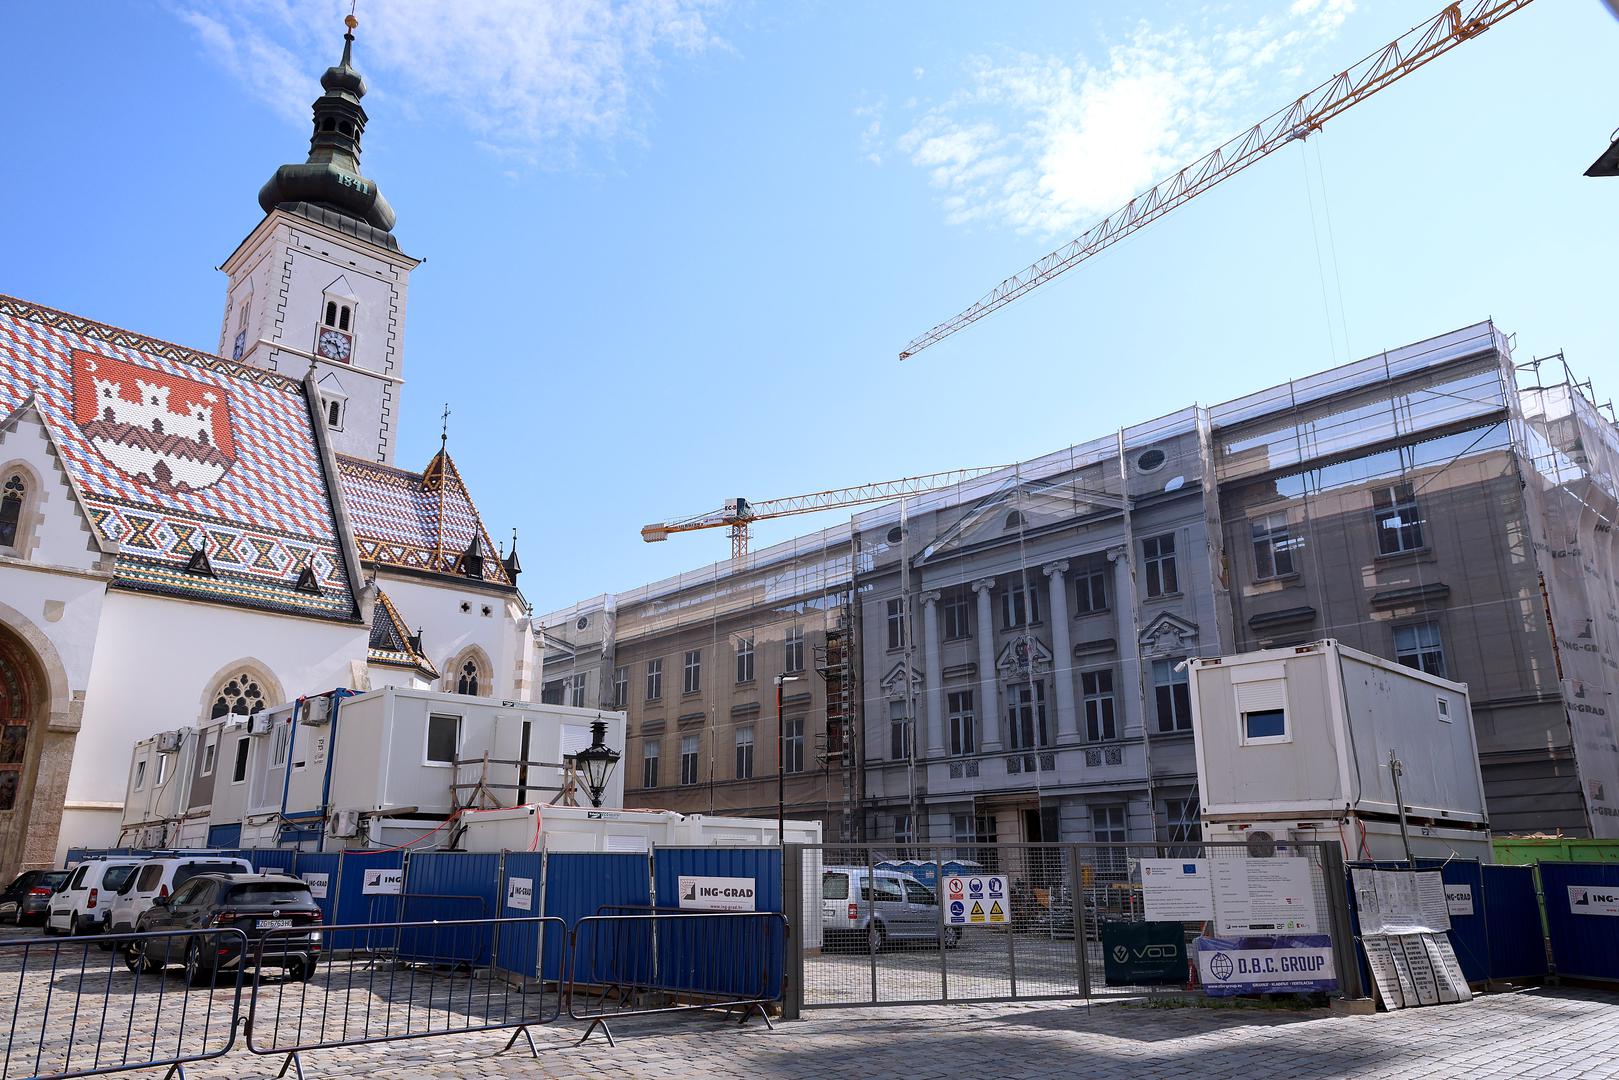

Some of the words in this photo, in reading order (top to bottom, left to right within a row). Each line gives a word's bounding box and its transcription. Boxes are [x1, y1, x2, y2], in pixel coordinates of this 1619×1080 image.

[336, 172, 369, 194] 1841
[700, 887, 754, 898] ING-GRAD
[1446, 893, 1471, 901] NG-GRAD
[1132, 944, 1177, 958] VOD
[1238, 957, 1278, 974] D.B.C.
[1281, 955, 1325, 973] GROUP
